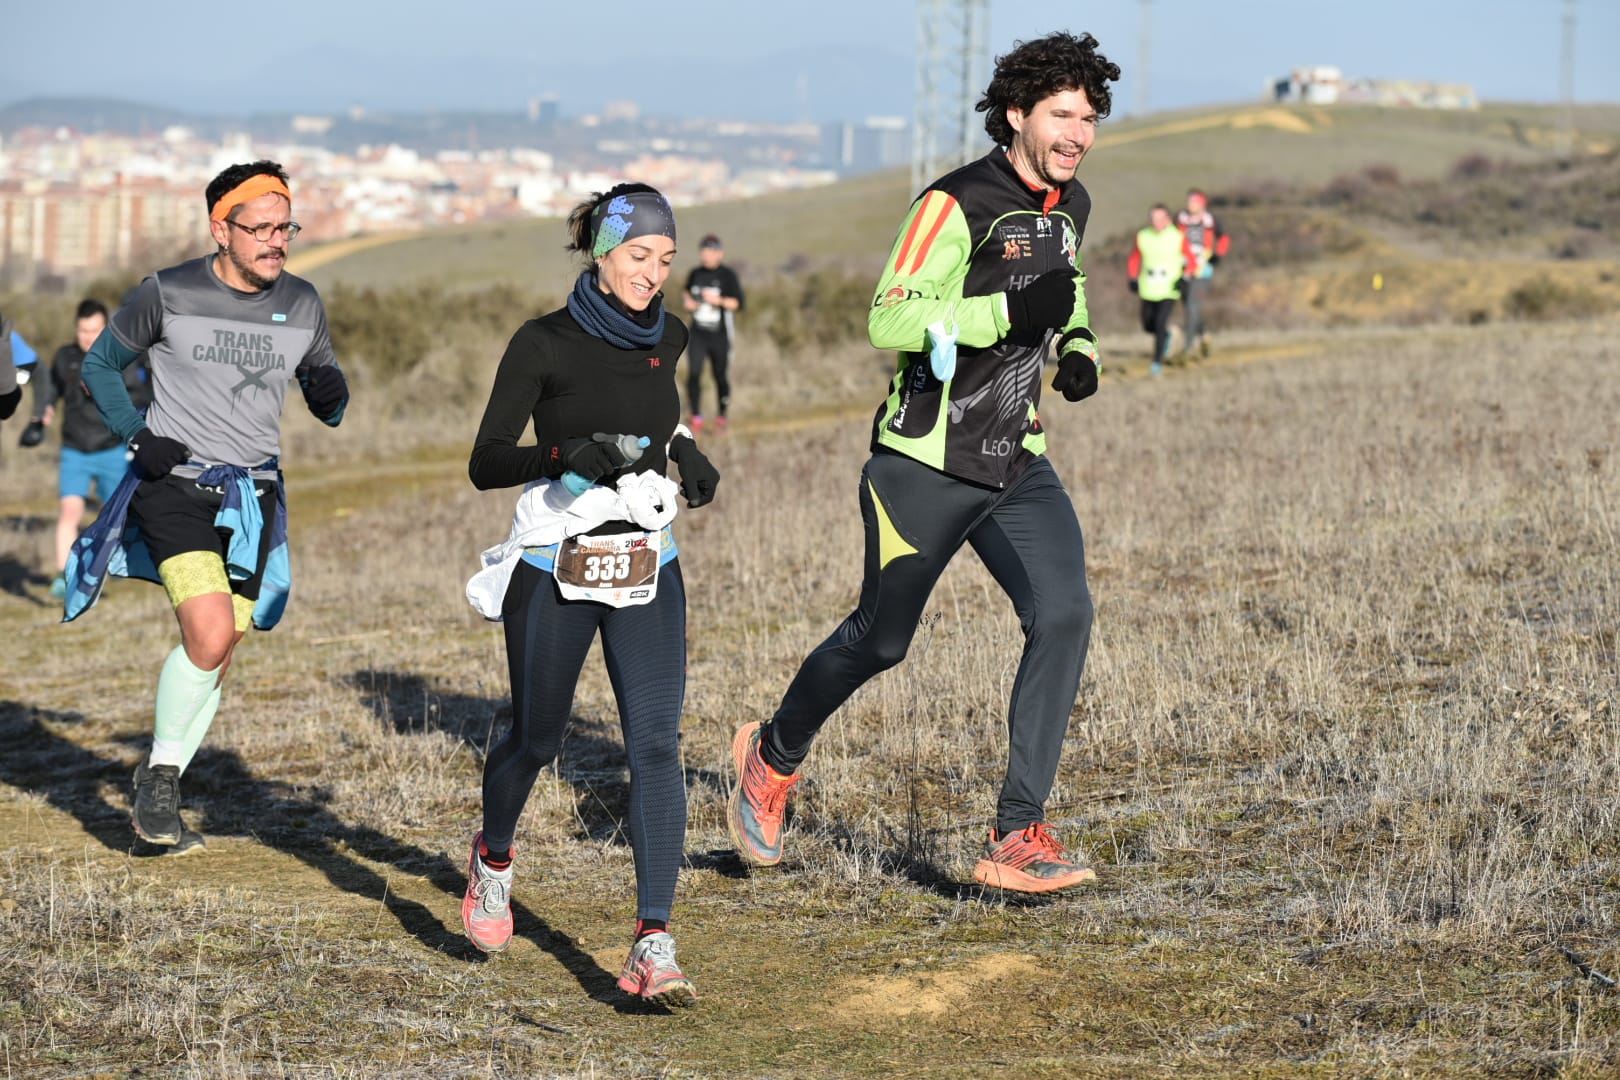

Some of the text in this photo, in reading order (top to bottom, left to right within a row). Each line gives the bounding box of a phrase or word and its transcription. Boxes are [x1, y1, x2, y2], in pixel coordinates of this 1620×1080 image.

[213, 329, 274, 352] TRANS
[192, 344, 286, 370] CANDAMIA
[625, 537, 649, 548] 2022
[584, 554, 631, 582] 333
